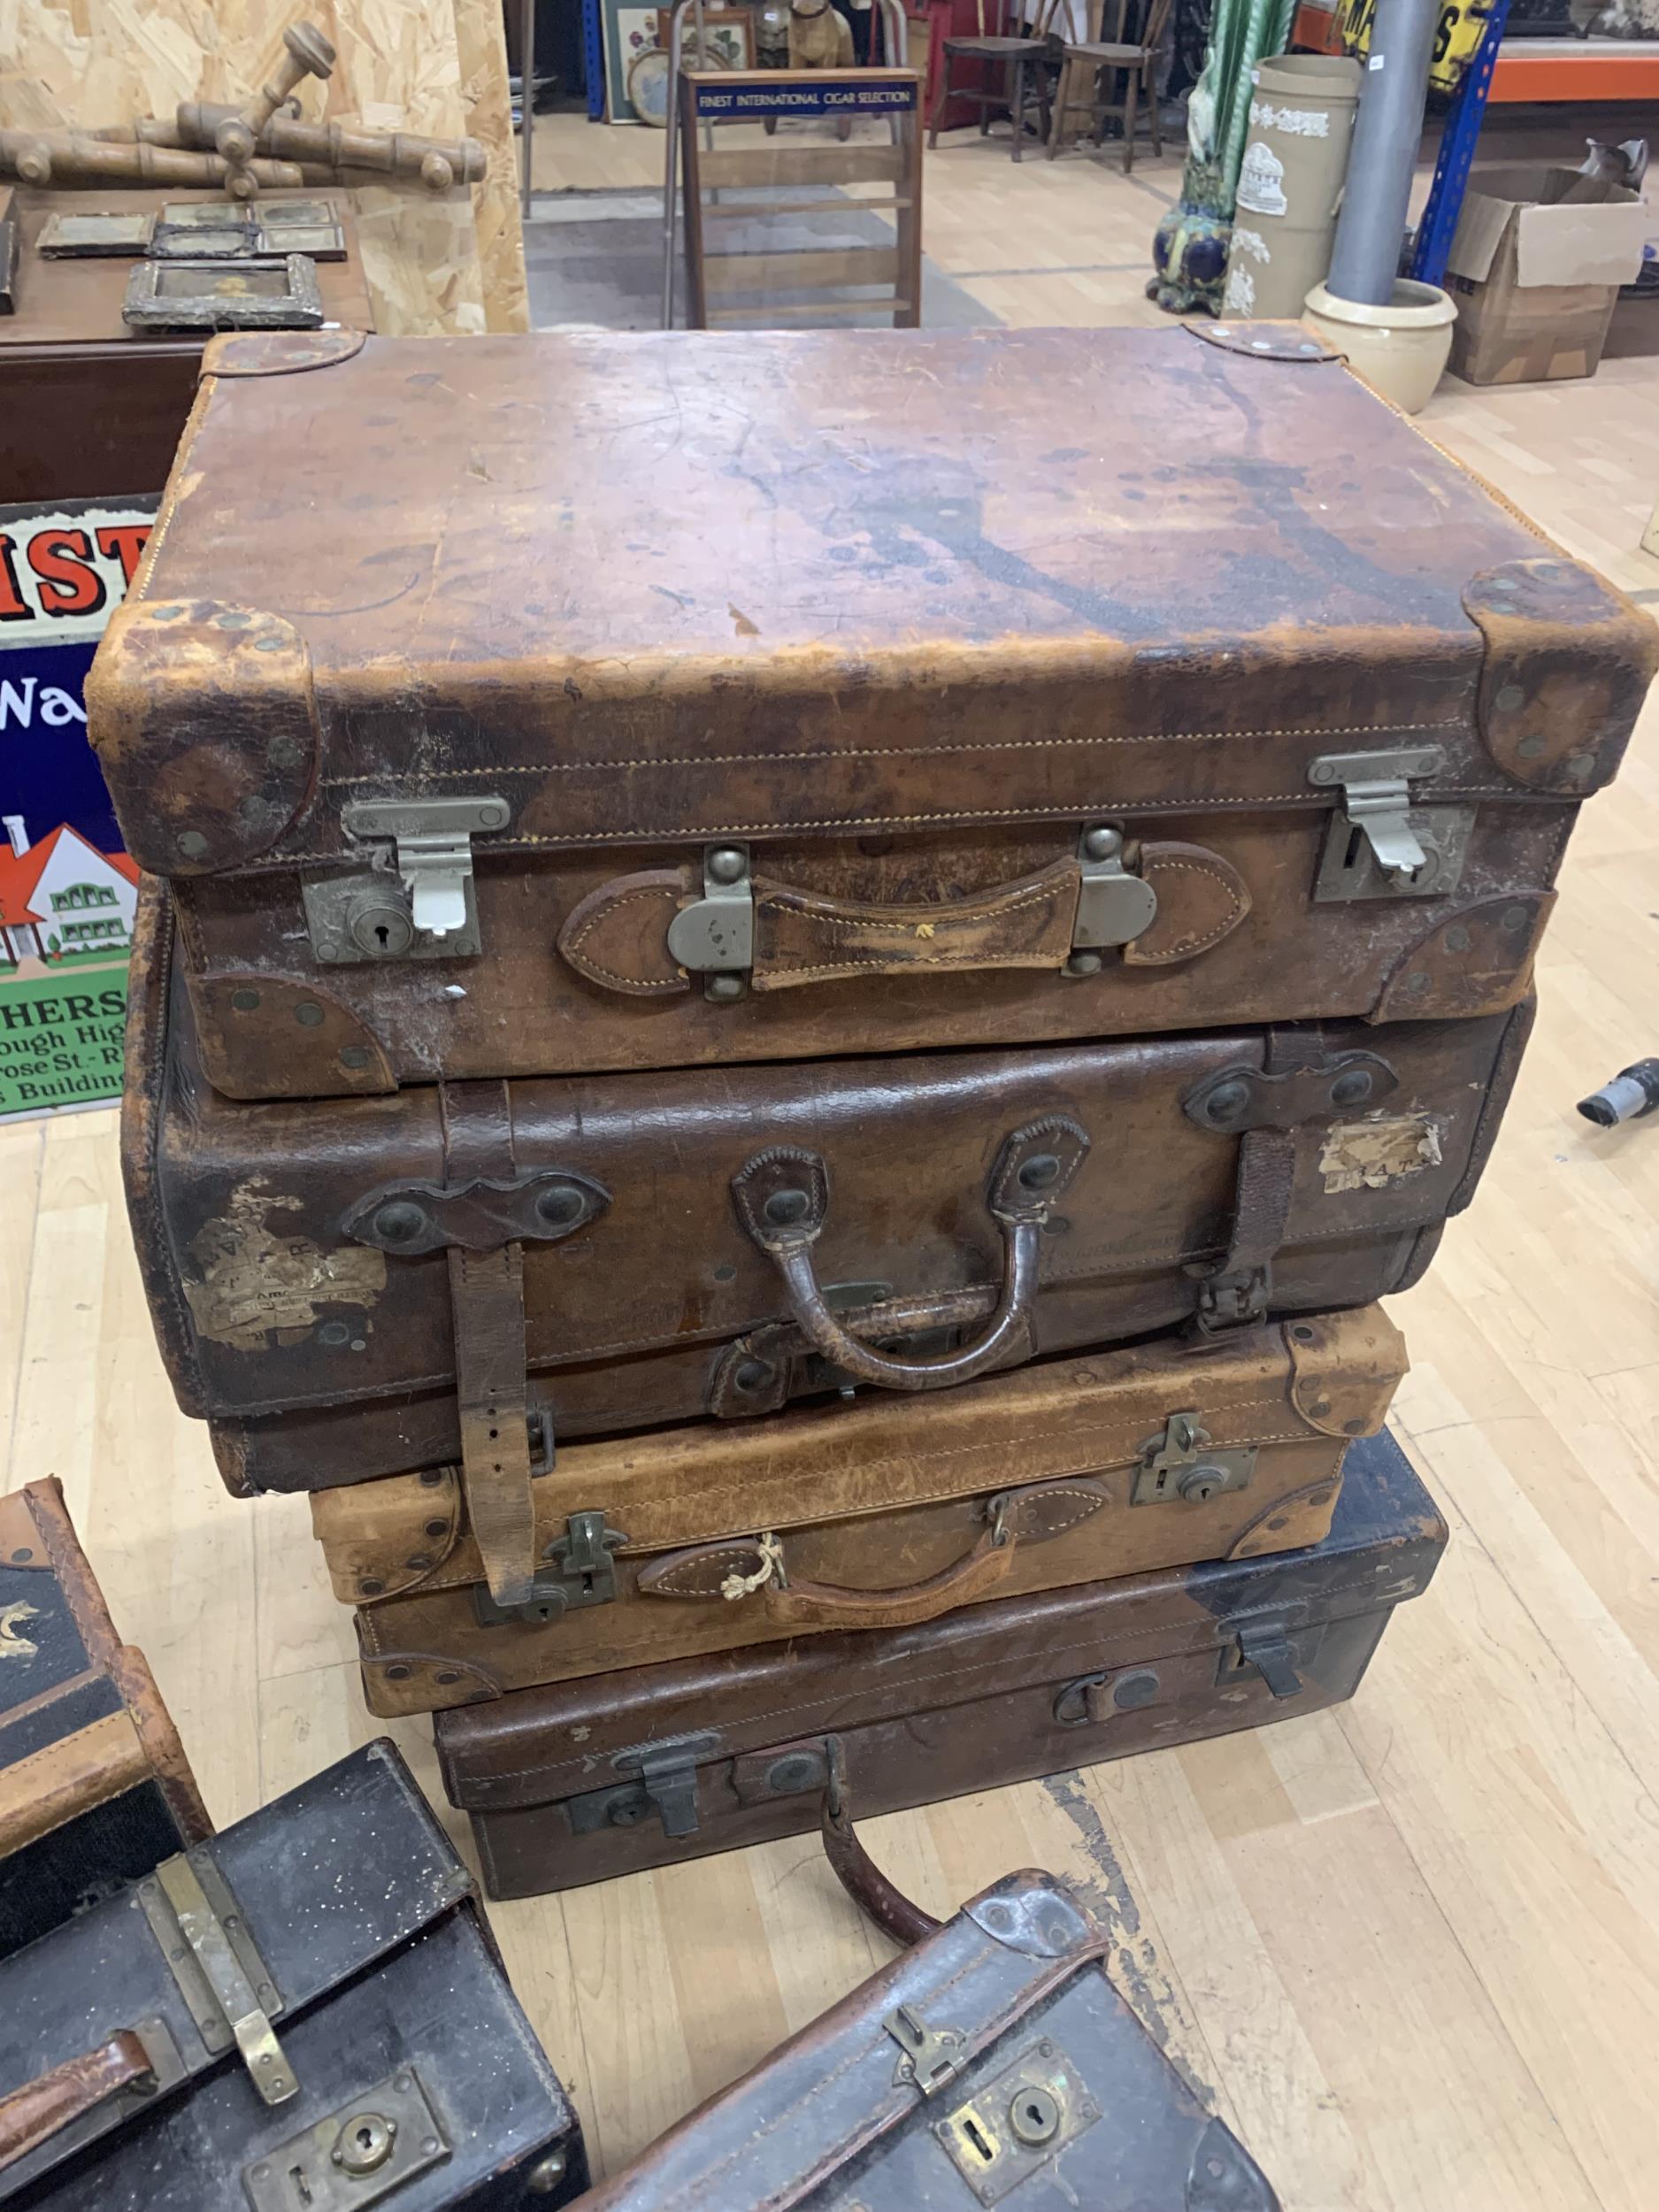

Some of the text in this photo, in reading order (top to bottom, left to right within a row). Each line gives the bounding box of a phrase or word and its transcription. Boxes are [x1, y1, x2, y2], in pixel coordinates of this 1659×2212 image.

[699, 90, 910, 107] FINEST INTERNATIONAL CIGAR SELECTION
[0, 1061, 49, 1079] ose
